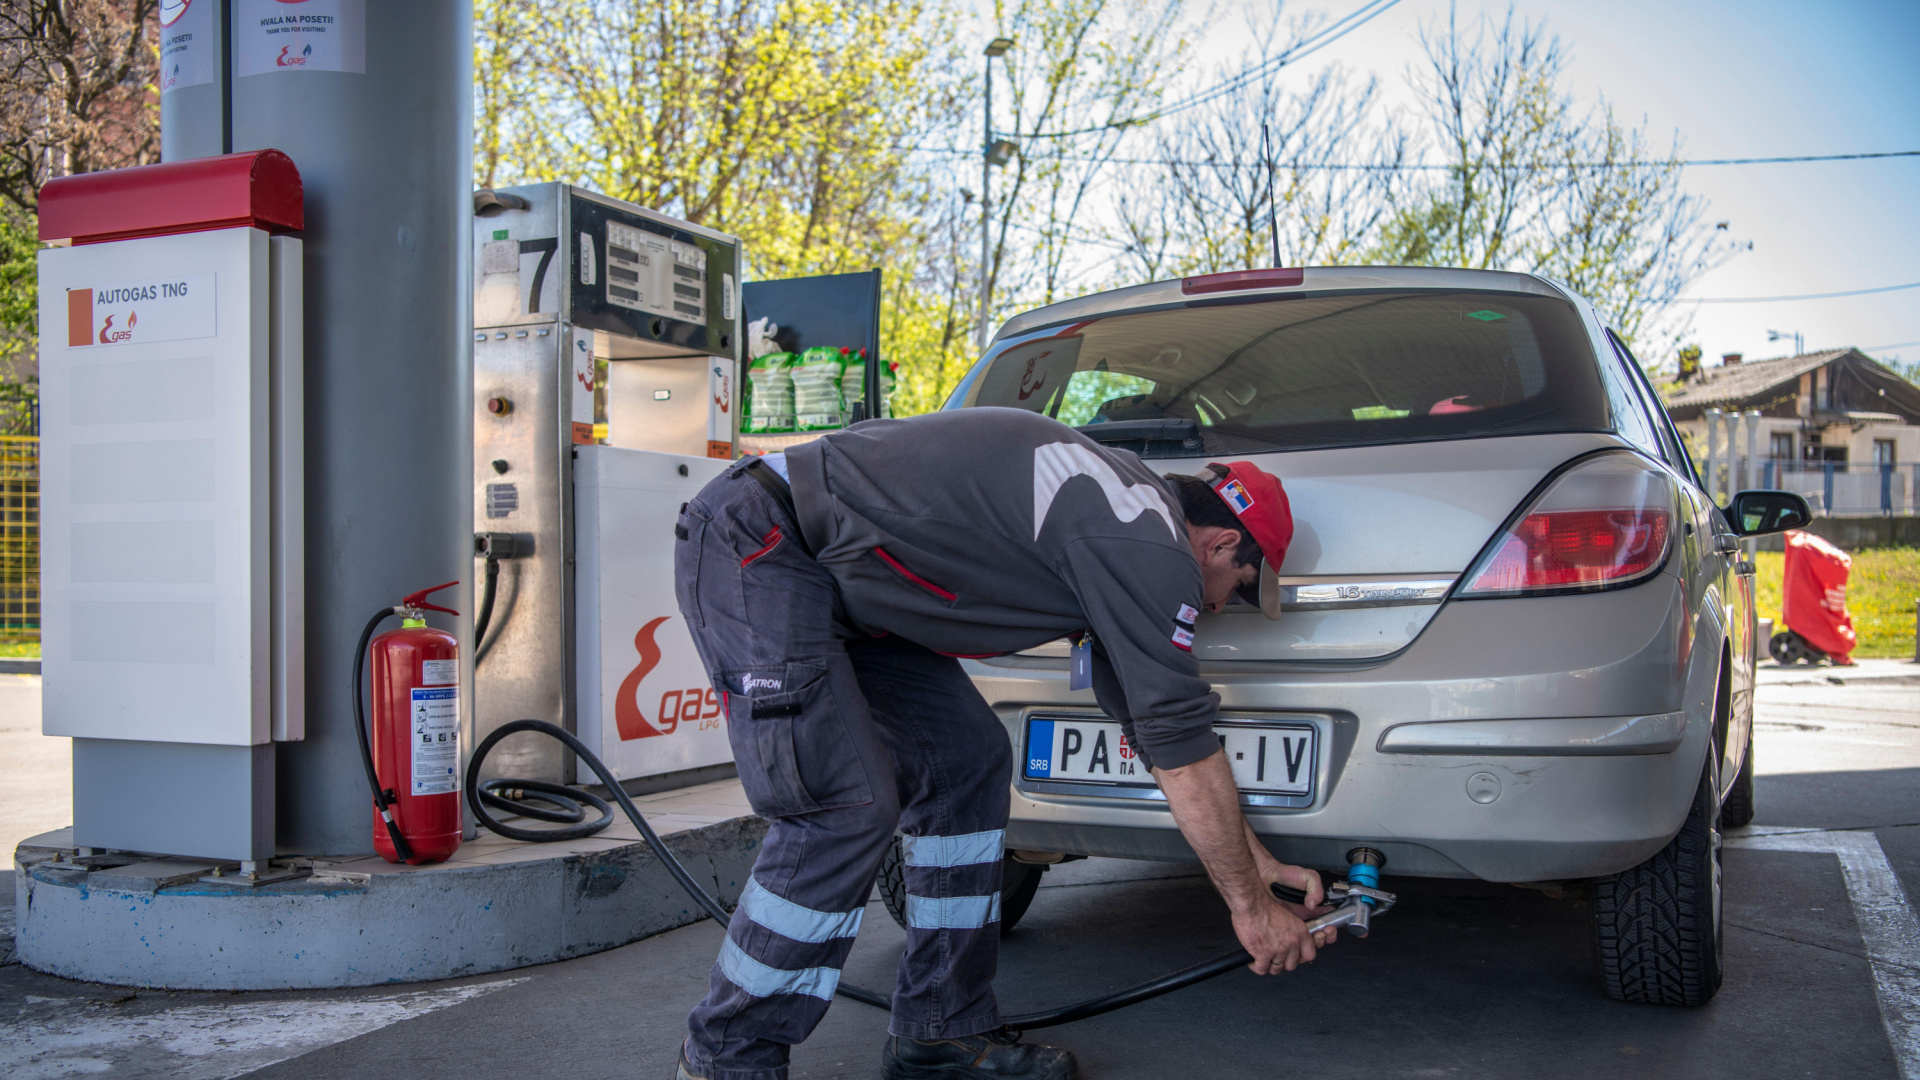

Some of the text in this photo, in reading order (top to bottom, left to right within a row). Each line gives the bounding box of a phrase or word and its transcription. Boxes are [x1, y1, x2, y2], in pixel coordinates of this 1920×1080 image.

[260, 15, 334, 27] HVALA NA POSETI!
[519, 236, 559, 314] 7
[97, 281, 188, 306] AUTOGAS TNG
[1336, 585, 1426, 599] 1.6 TWINPORT
[698, 718, 720, 731] LPG
[1060, 728, 1111, 775] PA
[1030, 759, 1049, 771] SRB
